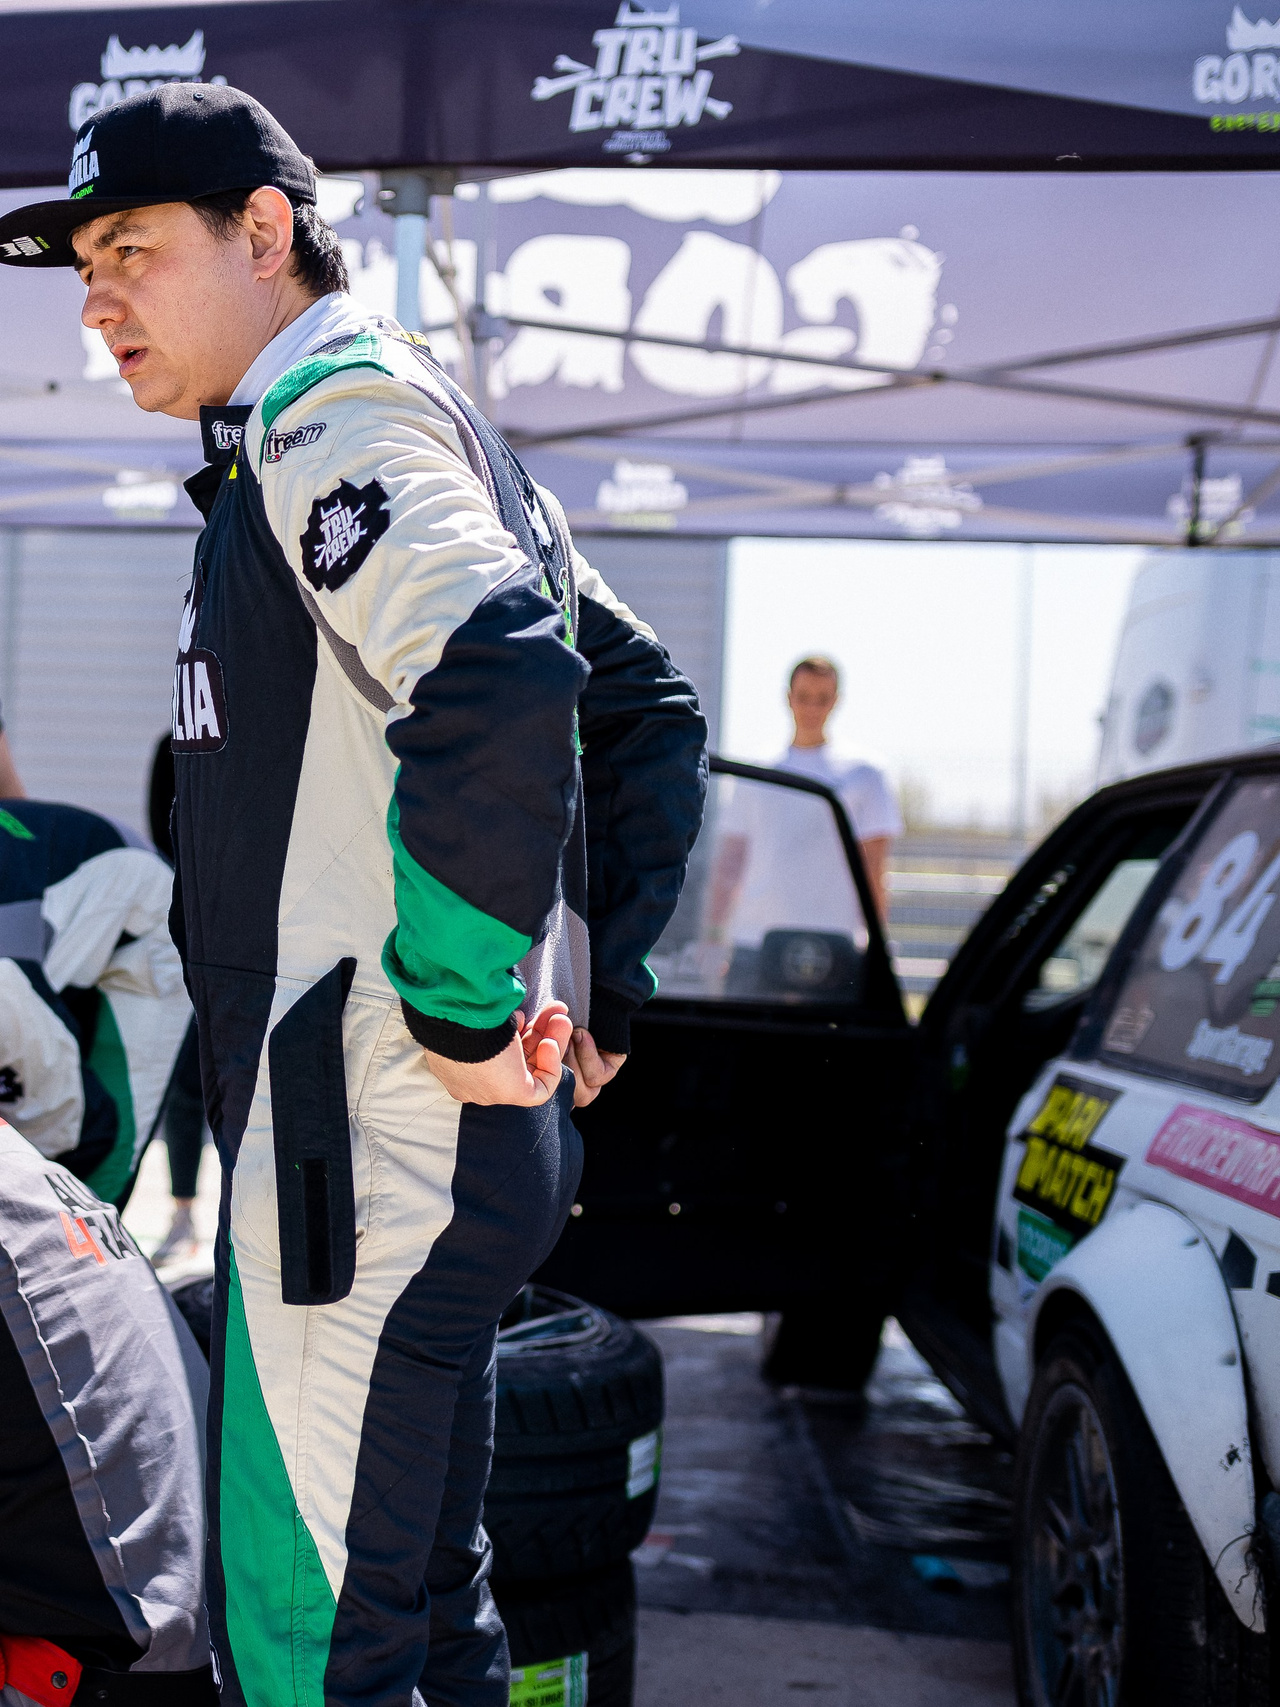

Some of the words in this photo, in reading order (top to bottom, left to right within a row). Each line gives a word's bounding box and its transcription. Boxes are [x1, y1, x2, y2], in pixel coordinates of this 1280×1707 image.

[592, 26, 698, 79] TRU
[1193, 52, 1280, 104] GOR
[569, 69, 714, 133] CREW
[265, 423, 327, 462] freem
[320, 506, 354, 543] TRU
[325, 521, 362, 572] CREW
[1160, 830, 1280, 984] 84
[1028, 1083, 1110, 1148] PARI
[1016, 1136, 1114, 1226] MATCH
